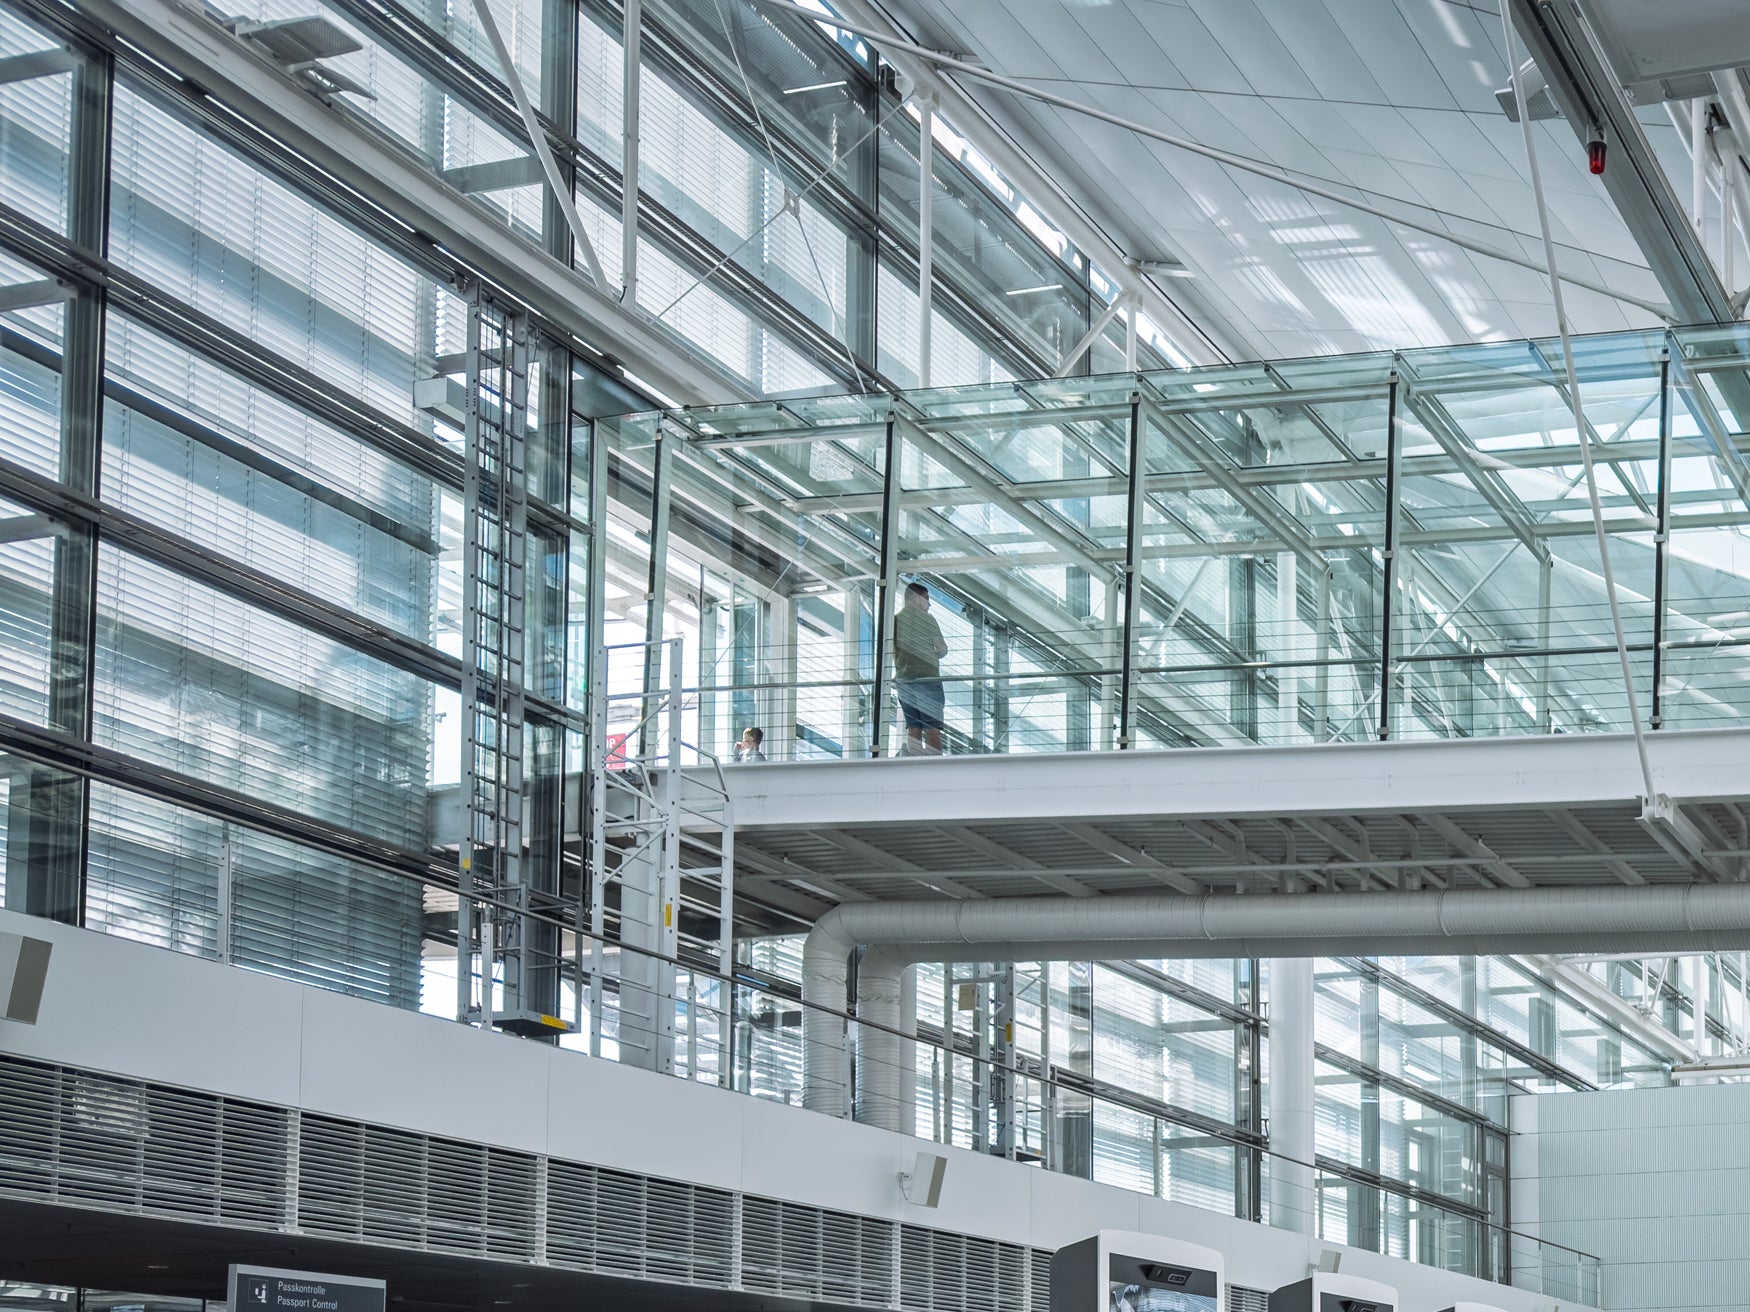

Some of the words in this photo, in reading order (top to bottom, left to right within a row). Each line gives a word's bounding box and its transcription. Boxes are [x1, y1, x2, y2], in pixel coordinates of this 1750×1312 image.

[278, 1280, 326, 1295] Passkontrolle
[277, 1295, 310, 1308] Passport
[311, 1298, 338, 1310] Control
